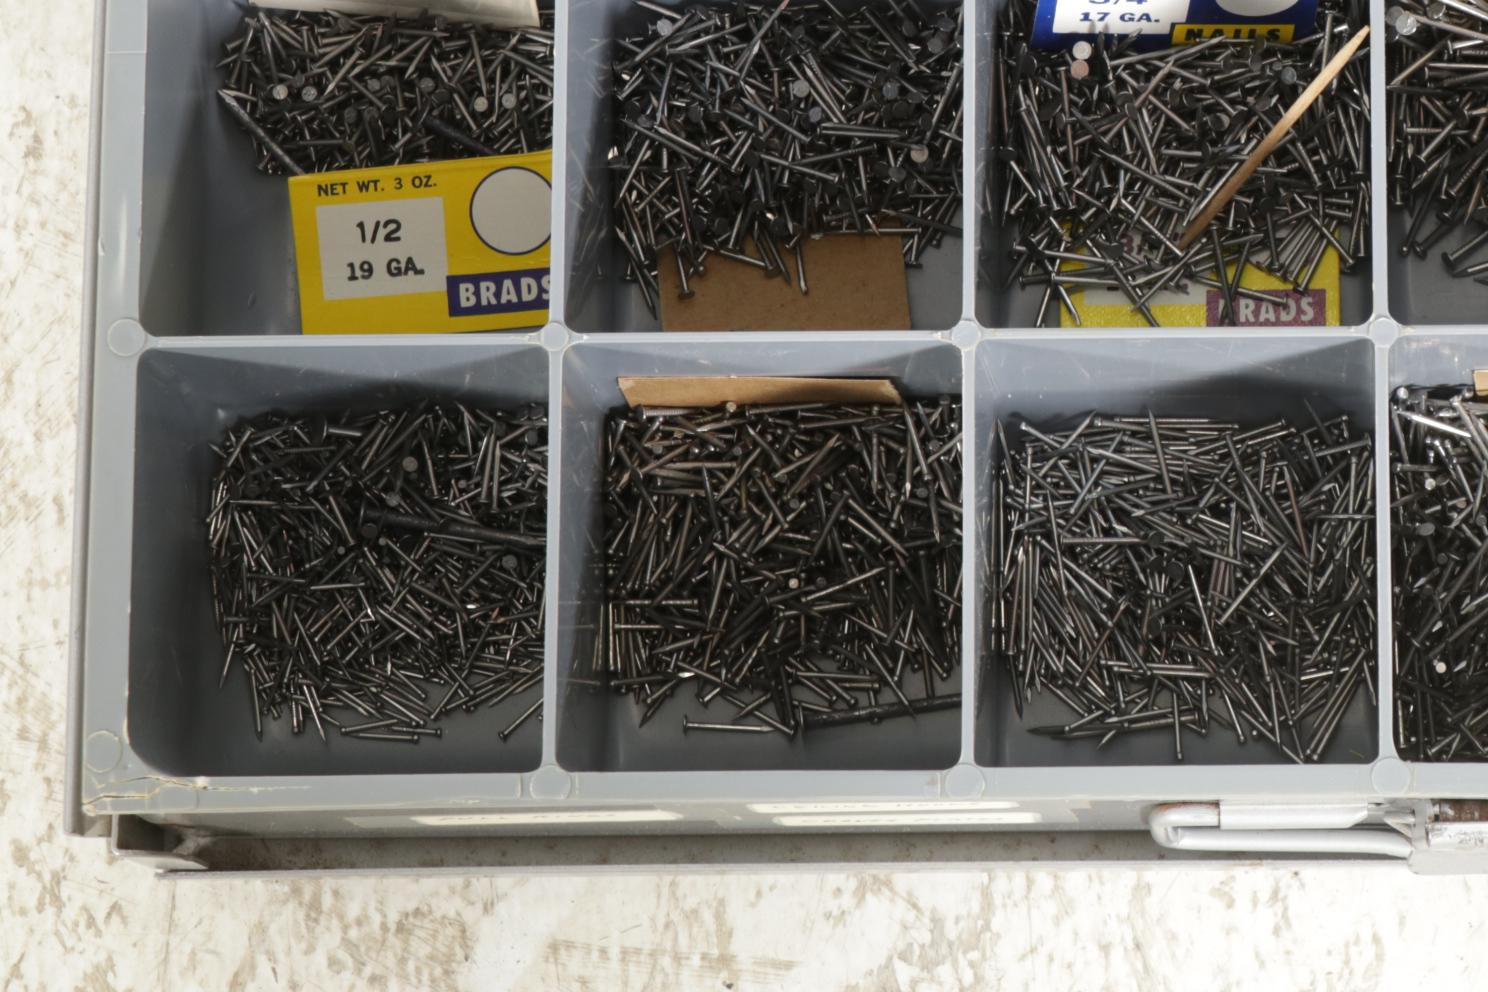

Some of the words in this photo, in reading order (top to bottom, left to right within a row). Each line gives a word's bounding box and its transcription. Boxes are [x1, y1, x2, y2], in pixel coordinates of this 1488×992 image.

[1079, 11, 1111, 22] 17
[1119, 11, 1161, 23] GA.
[317, 182, 348, 197] NET
[356, 179, 385, 193] WT.
[394, 177, 403, 190] 3
[411, 175, 437, 188] OZ.
[356, 218, 402, 245] 1/2
[346, 260, 374, 281] 19
[386, 256, 425, 277] GA.
